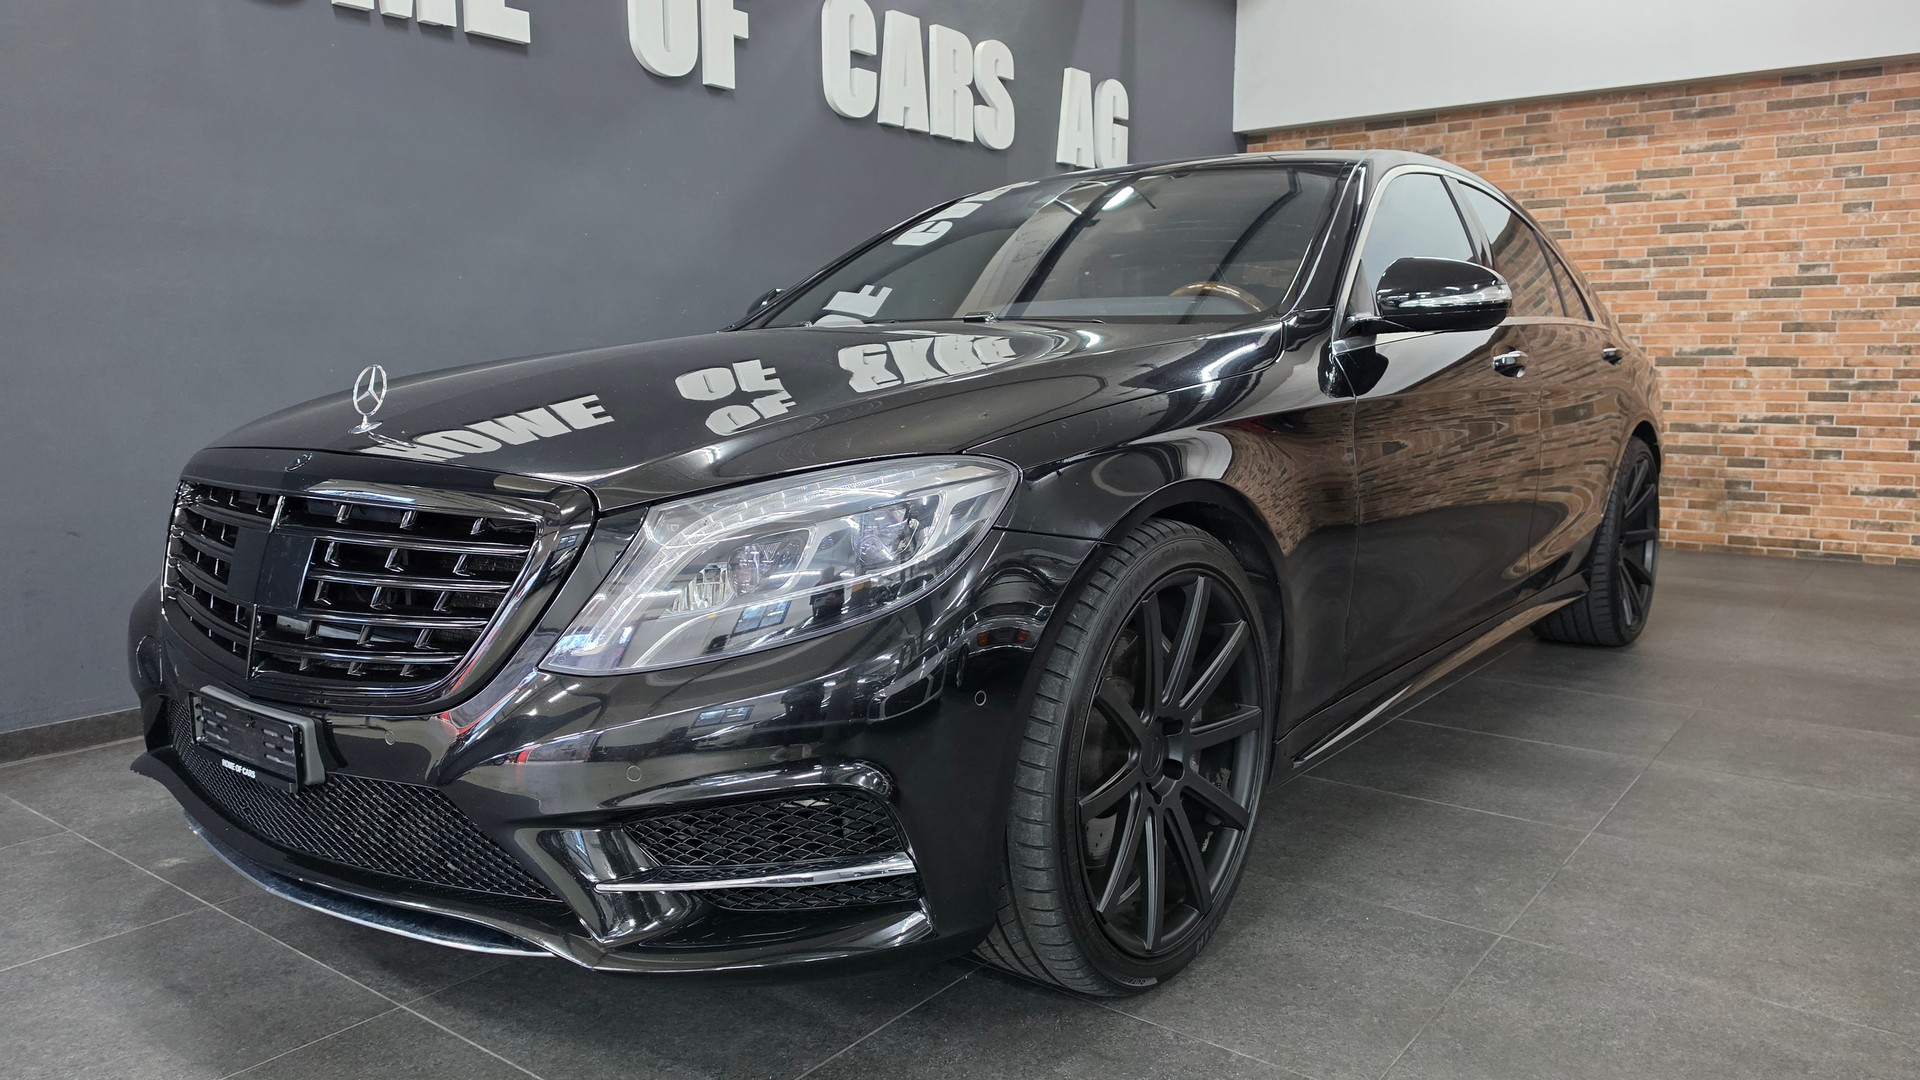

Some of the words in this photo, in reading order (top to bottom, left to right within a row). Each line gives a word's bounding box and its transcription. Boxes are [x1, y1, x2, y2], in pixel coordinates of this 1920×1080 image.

[821, 0, 1015, 150] CARS
[1056, 67, 1129, 168] AG
[221, 758, 236, 771] HOME
[235, 764, 243, 773] OF
[242, 767, 256, 779] CARS
